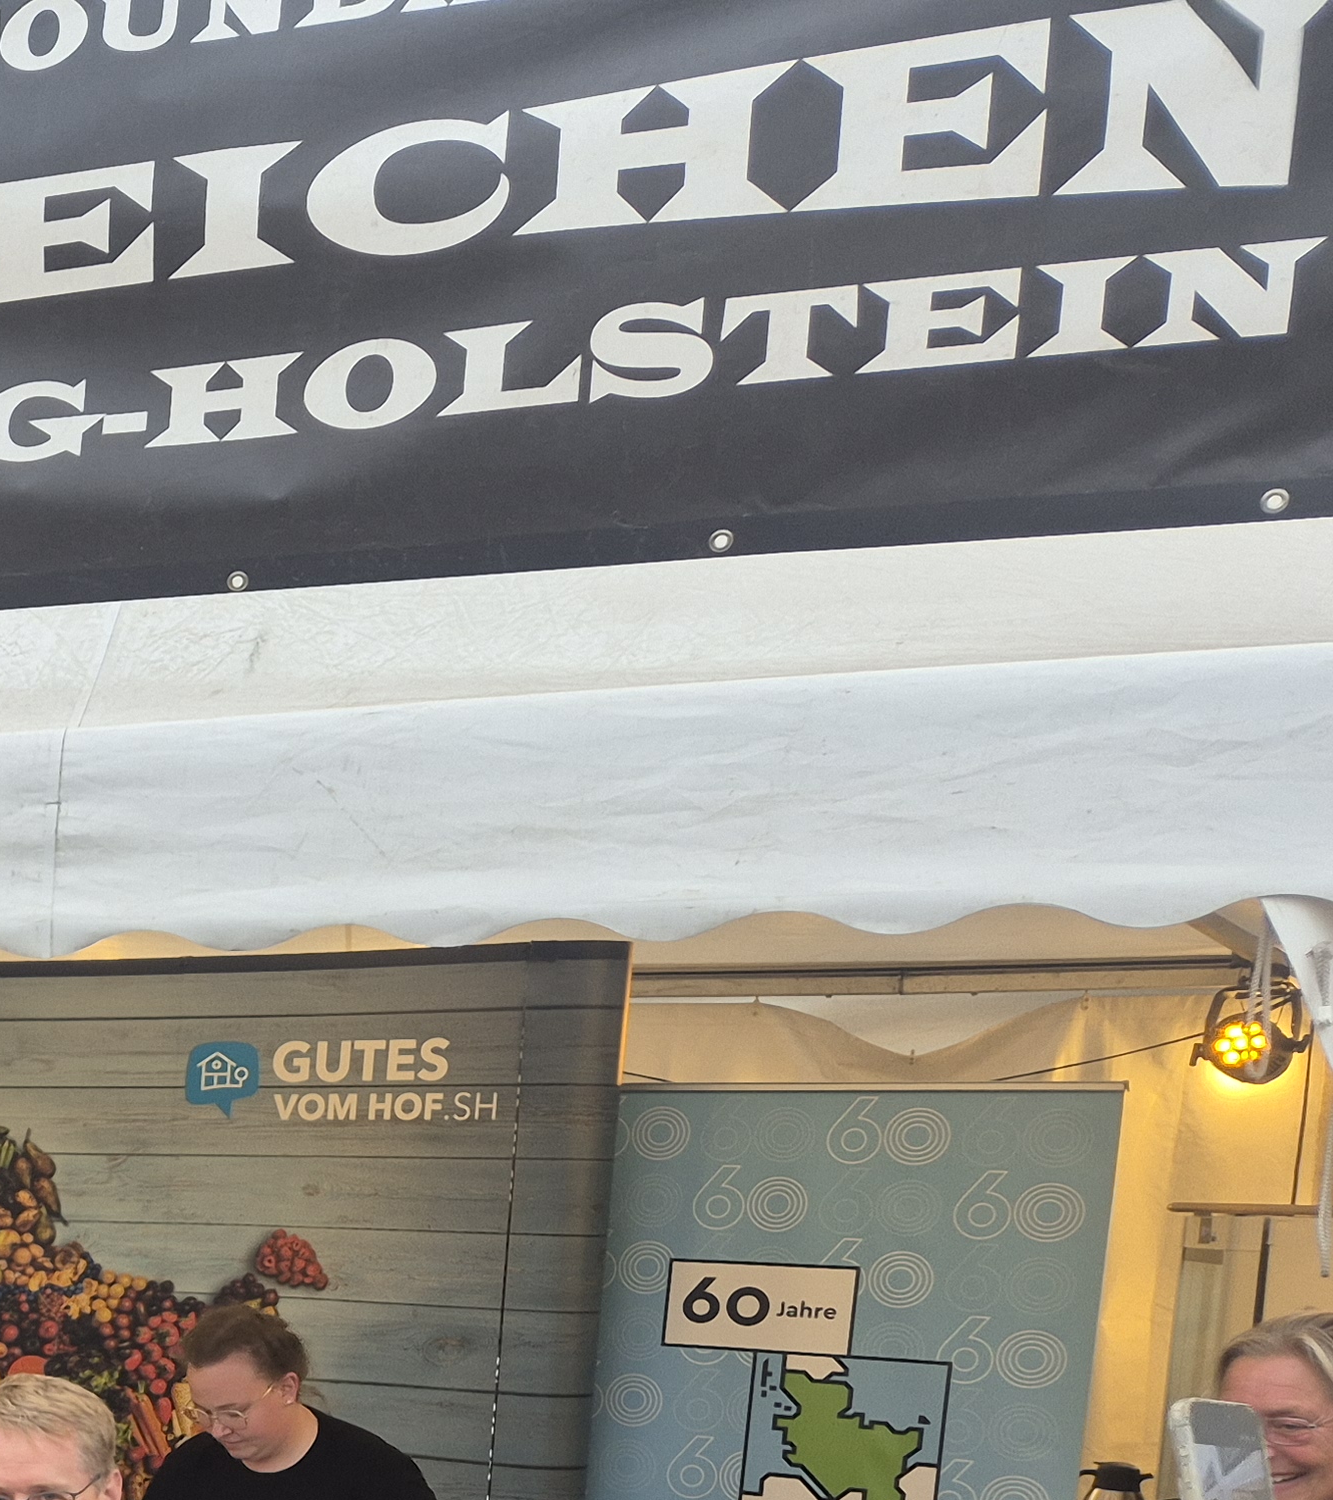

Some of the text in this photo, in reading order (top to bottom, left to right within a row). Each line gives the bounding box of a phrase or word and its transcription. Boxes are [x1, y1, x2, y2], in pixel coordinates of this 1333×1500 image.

[272, 1037, 451, 1084] GUTES
[274, 1091, 498, 1121] VOM HOF.SH
[827, 1096, 952, 1165] 60
[693, 1165, 808, 1232] 60
[953, 1170, 1086, 1242] 60
[683, 1277, 837, 1326] 60 Jahre
[937, 1316, 1067, 1388] 60
